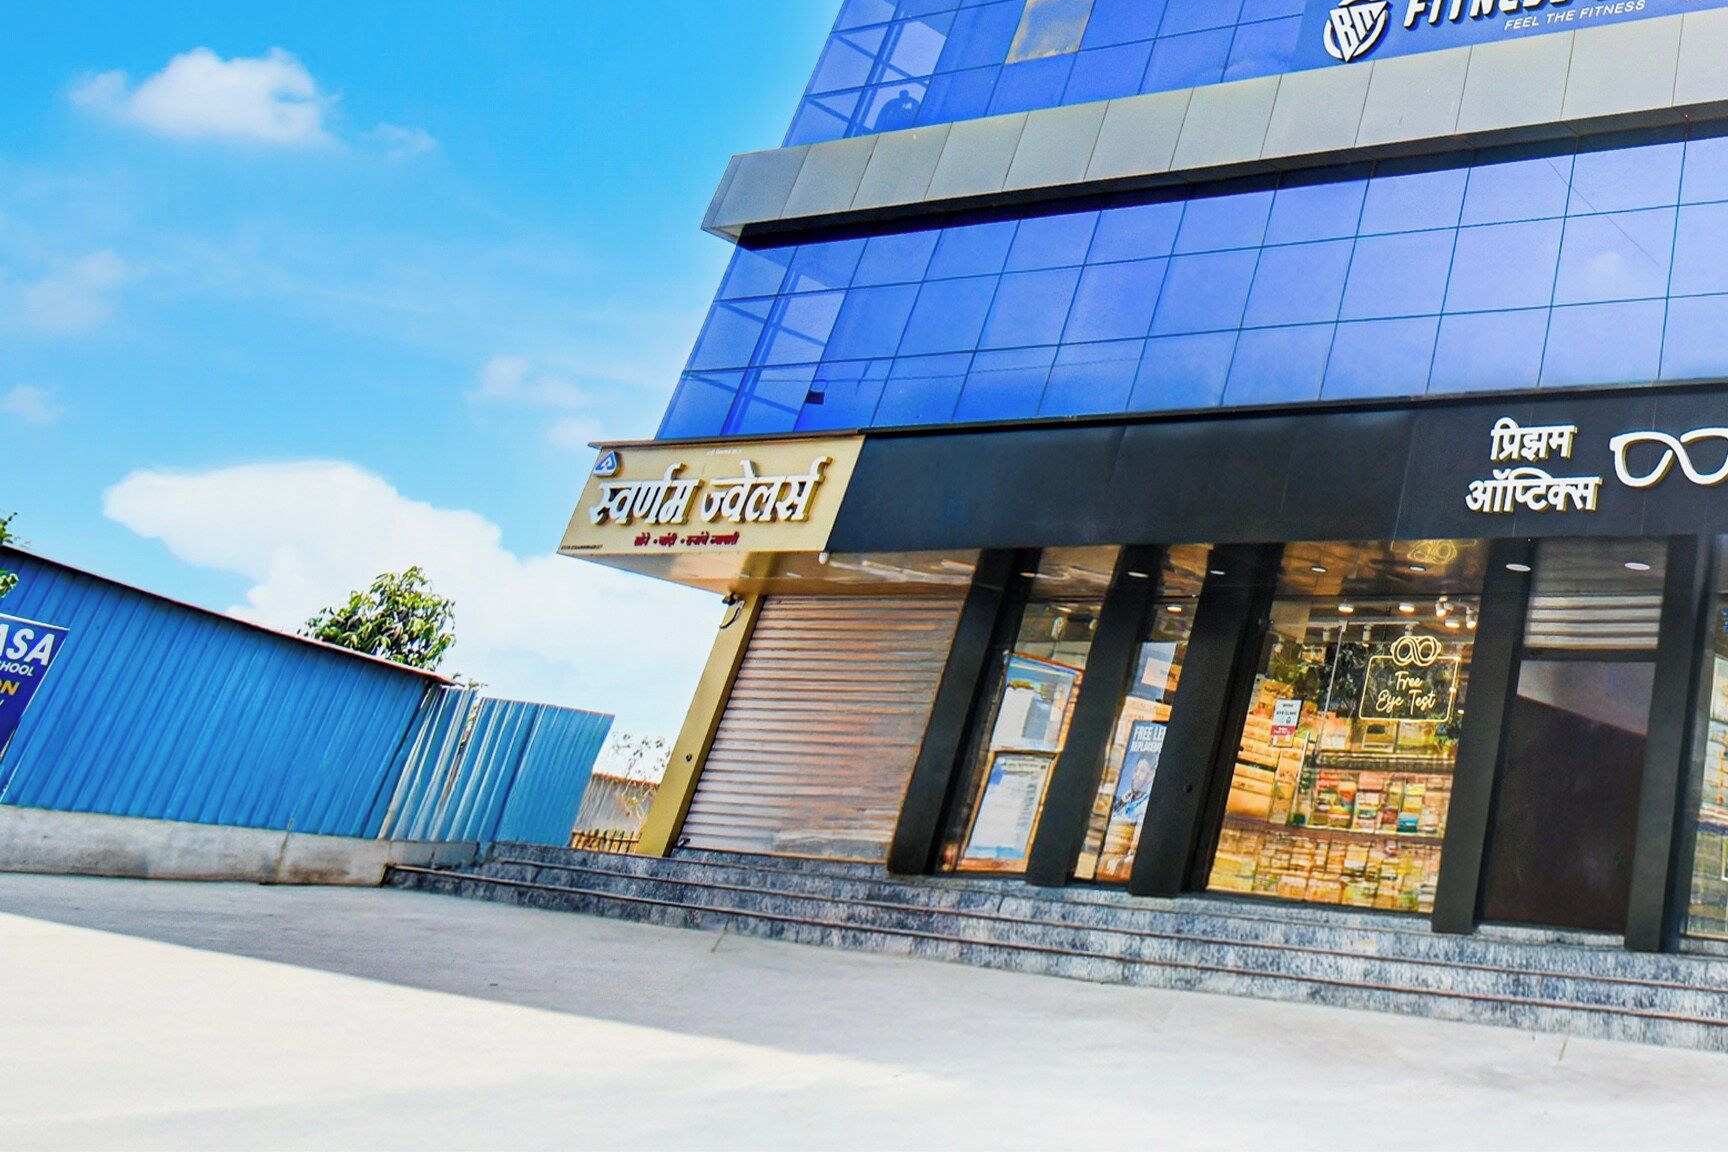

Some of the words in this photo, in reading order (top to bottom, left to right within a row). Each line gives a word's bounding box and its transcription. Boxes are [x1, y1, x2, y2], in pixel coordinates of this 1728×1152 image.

[1504, 13, 1540, 32] FEEL
[1546, 8, 1576, 25] THE
[1579, 0, 1646, 20] FITNESS
[1490, 417, 1578, 461] प्रिझम
[700, 456, 833, 523] ज्वेलर्स
[1466, 466, 1602, 513] ऑप्टिक्स
[0, 659, 34, 676] HOOL
[1395, 670, 1423, 691] Free
[1375, 690, 1404, 714] Eye
[1408, 690, 1436, 715] Test
[1133, 725, 1152, 740] FREE
